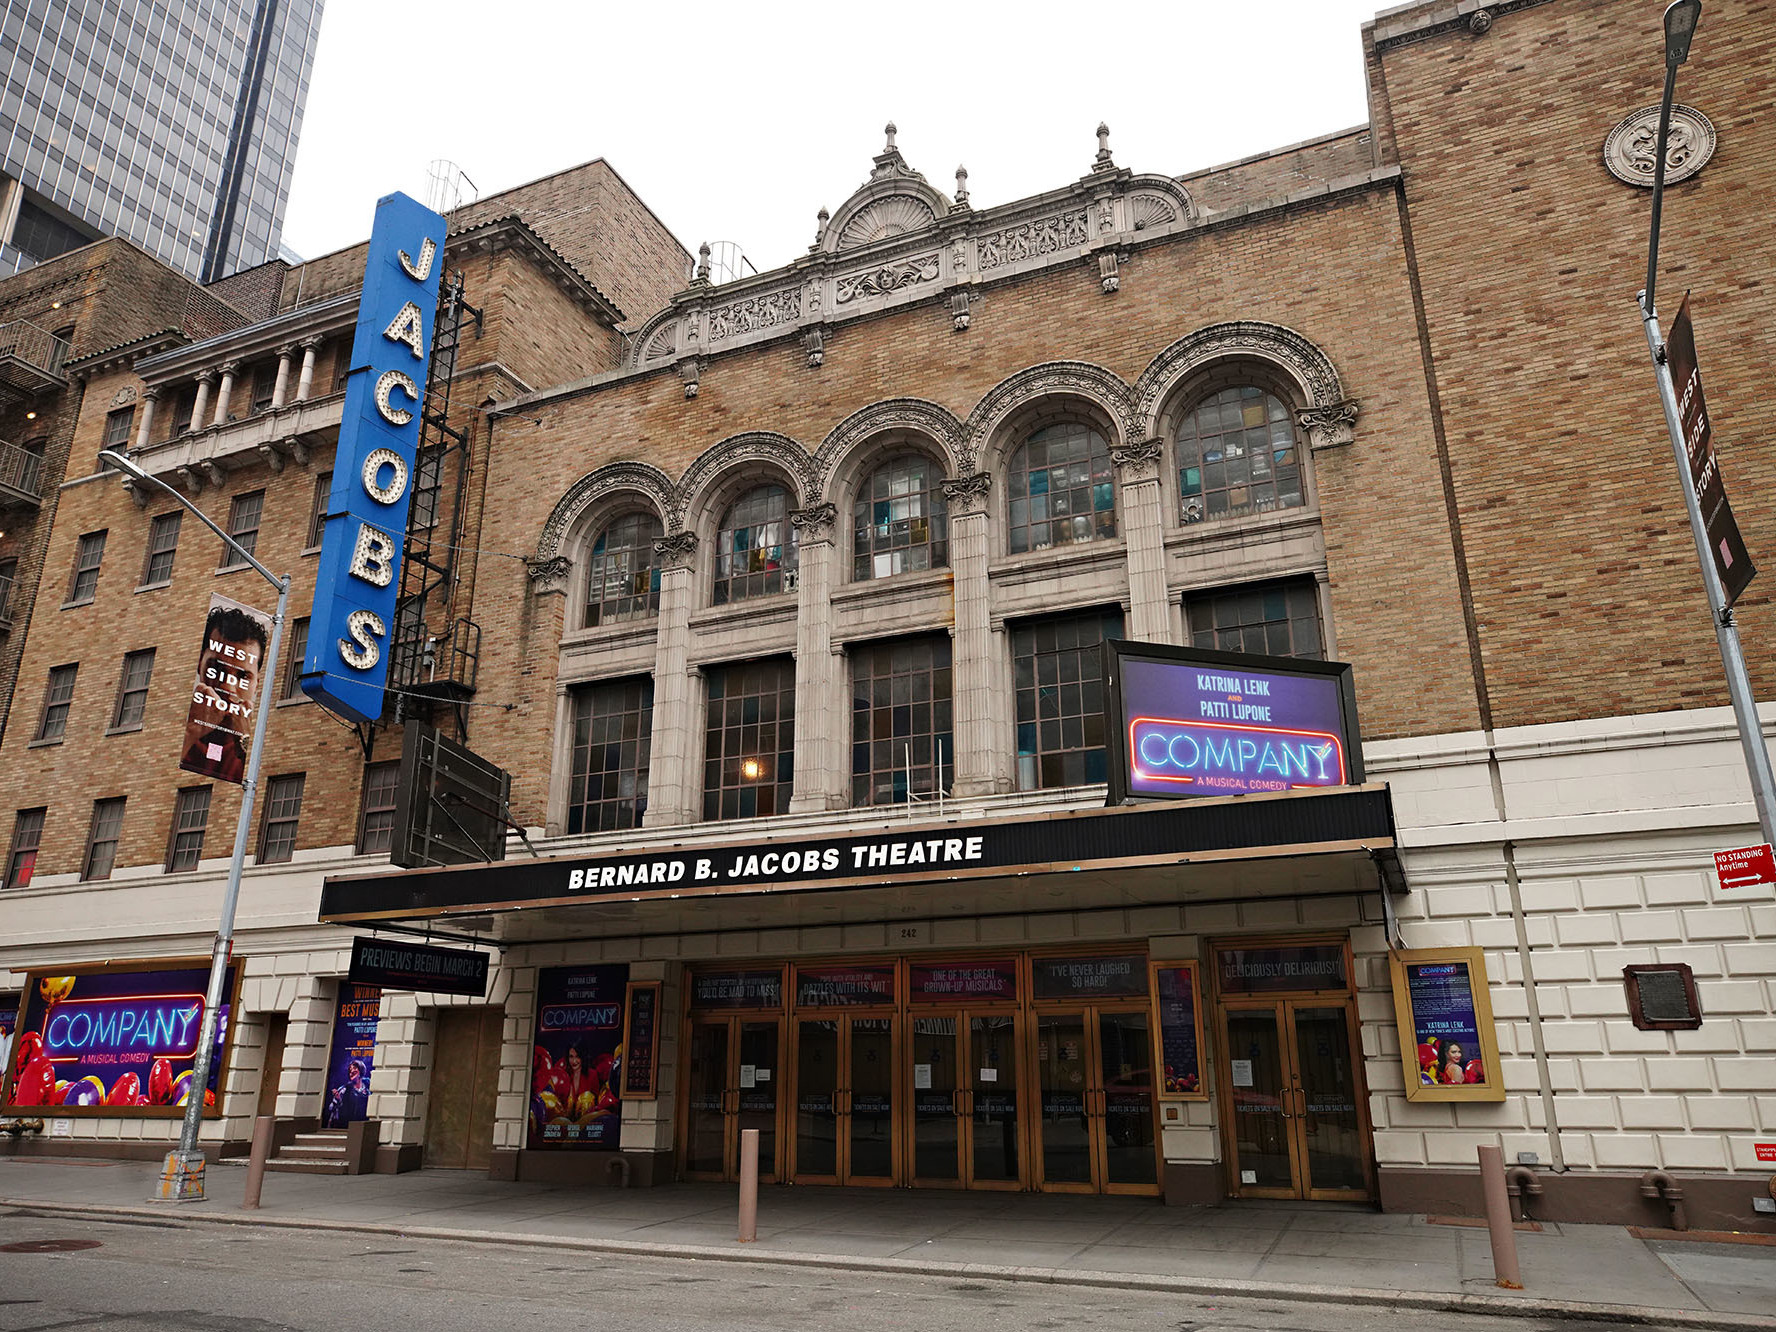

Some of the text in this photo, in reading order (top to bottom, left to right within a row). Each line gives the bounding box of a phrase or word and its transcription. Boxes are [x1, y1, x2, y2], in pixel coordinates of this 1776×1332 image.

[1678, 367, 1698, 420] WEST
[1687, 412, 1706, 459] SIDE
[337, 236, 437, 671] JACOBS
[209, 639, 258, 665] WEST
[206, 667, 250, 691] SIDE
[1197, 674, 1270, 696] KATRINA LENK
[193, 692, 252, 718] STORY
[1200, 700, 1272, 722] PATTI LUPONE
[1140, 733, 1333, 780] COMPANY
[1197, 776, 1288, 791] A MUSICAL COMEDY
[568, 836, 984, 890] BERNARD B. JACOBS THEATRE
[1716, 848, 1764, 863] NO STANDING
[1720, 861, 1748, 872] Anytime
[901, 928, 916, 938] 242
[360, 946, 412, 970] PREVIEWS
[414, 953, 442, 974] BEGIN
[443, 956, 474, 977] MARCH
[476, 960, 483, 978] 2
[1069, 964, 1093, 976] NEVER
[1095, 962, 1130, 976] LAUGHED
[948, 970, 958, 980] OF
[959, 969, 972, 980] THE
[974, 968, 996, 980] GREAT
[1072, 976, 1082, 988] SO
[718, 986, 728, 998] BE
[803, 981, 831, 993] DAZZLES
[832, 980, 851, 992] WITH
[852, 980, 864, 991] ITS
[924, 980, 964, 992] GROWN-UP
[341, 1004, 361, 1018] BEST
[544, 1008, 617, 1026] COMPANY
[48, 1003, 199, 1048] COMPANY
[1450, 1020, 1464, 1028] LENK
[80, 1052, 150, 1064] A MUSICAL COMEDY
